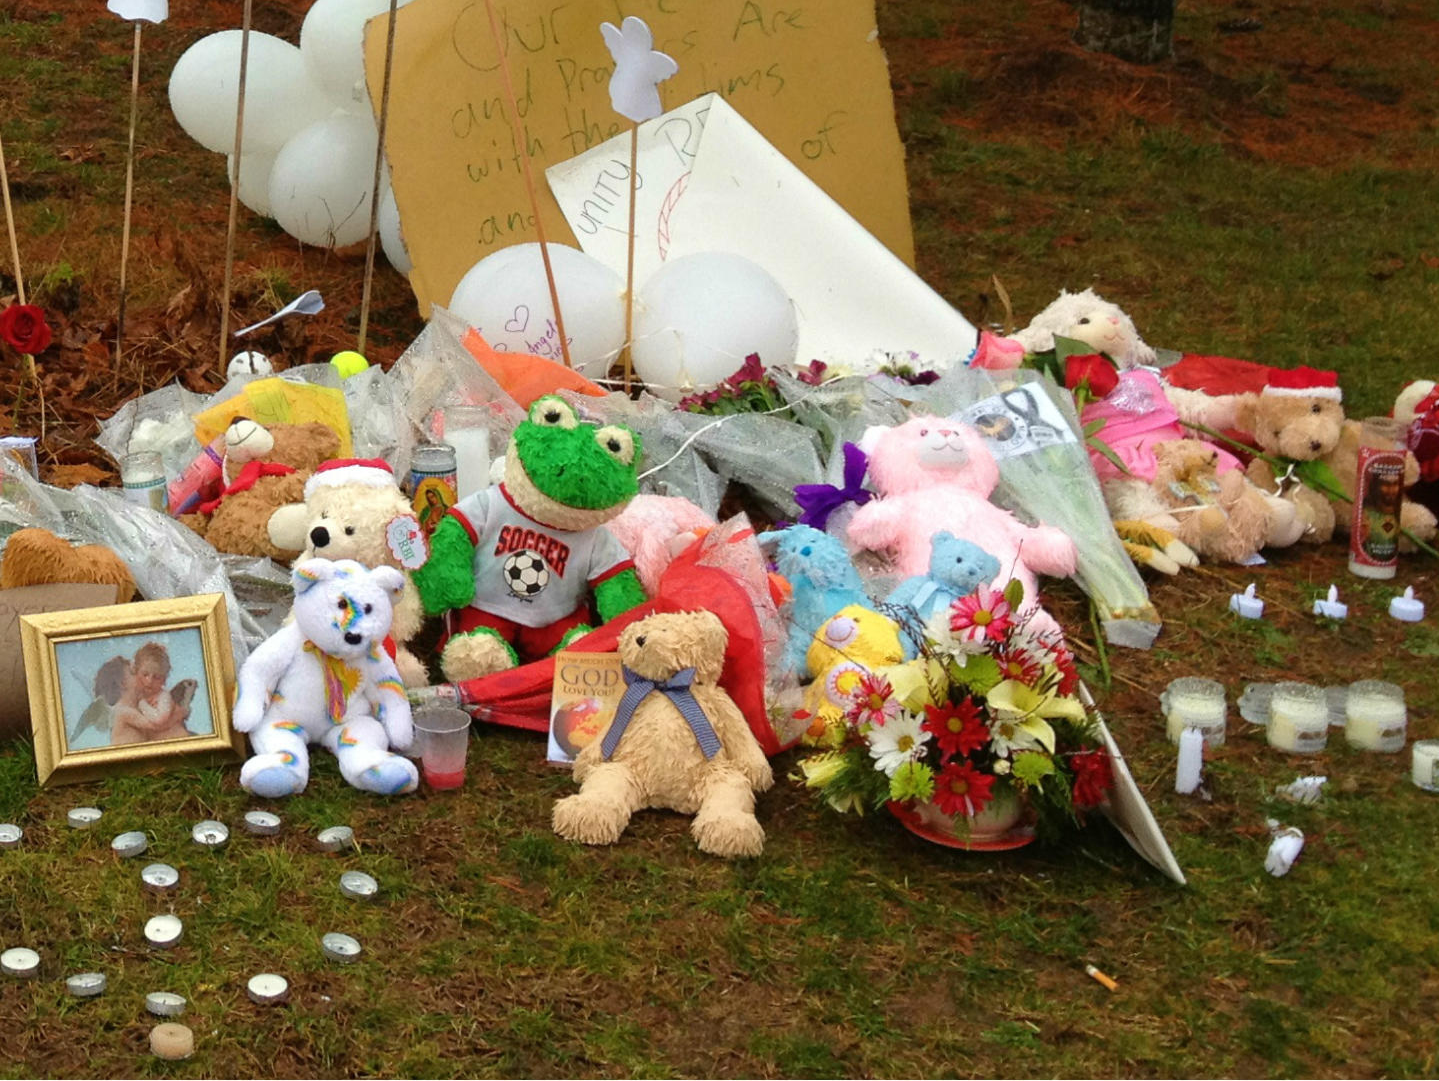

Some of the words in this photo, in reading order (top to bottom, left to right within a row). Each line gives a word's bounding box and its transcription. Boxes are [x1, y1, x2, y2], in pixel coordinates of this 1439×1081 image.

[451, 68, 533, 140] and
[558, 29, 699, 103] Prars
[732, 0, 808, 42] Are
[452, 0, 565, 72] Our
[467, 128, 545, 184] with
[562, 109, 622, 163] the
[799, 110, 847, 160] of
[494, 523, 570, 579] SOCCER
